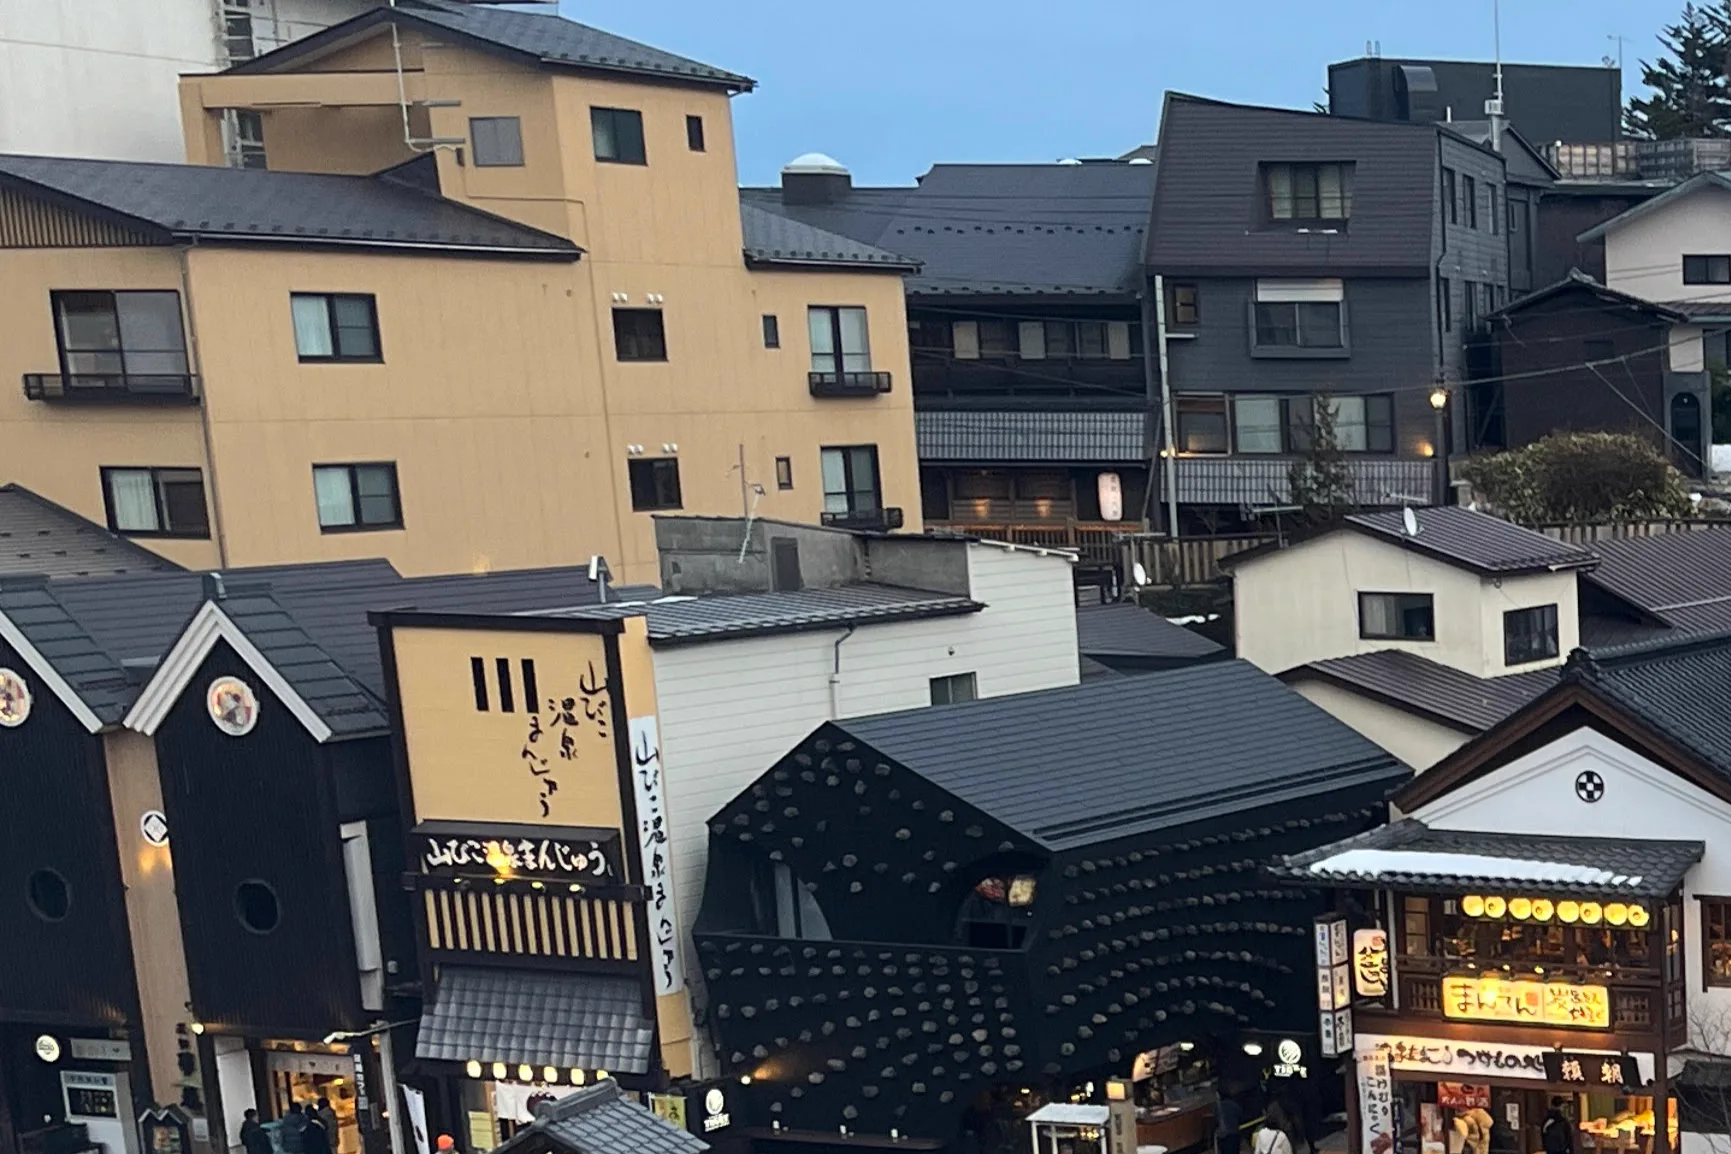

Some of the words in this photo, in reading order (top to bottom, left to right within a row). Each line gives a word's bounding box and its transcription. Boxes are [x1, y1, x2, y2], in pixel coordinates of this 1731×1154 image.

[548, 697, 579, 761] 温泉
[579, 661, 609, 738] 山びこ
[634, 730, 675, 990] 山びこ温泉まんじゅう
[1450, 983, 1538, 1017] まんてん
